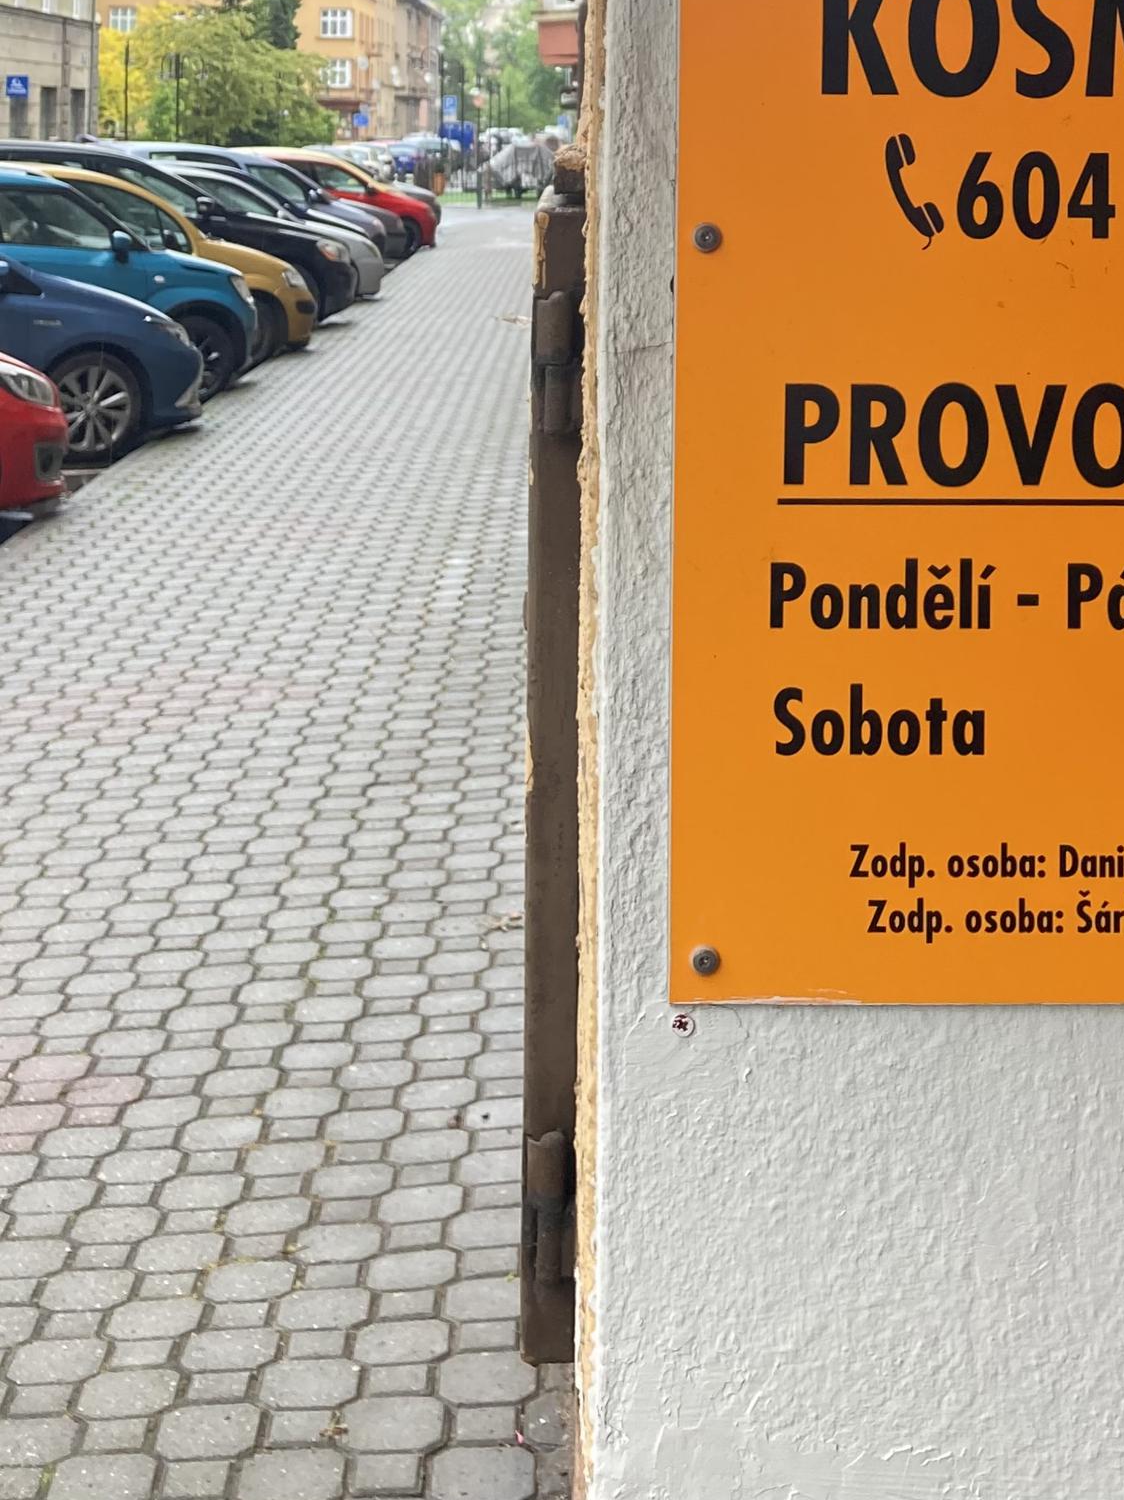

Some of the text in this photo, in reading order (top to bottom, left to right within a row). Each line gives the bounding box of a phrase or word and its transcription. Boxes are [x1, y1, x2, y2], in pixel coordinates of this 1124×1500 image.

[956, 151, 1116, 240] 604
[769, 558, 996, 630] Pondělí
[773, 683, 985, 757] Sobota
[849, 842, 935, 886] Zodp.
[947, 842, 1046, 878] osoba:
[867, 897, 953, 941] Zodp.
[965, 897, 1064, 934] osoba:
